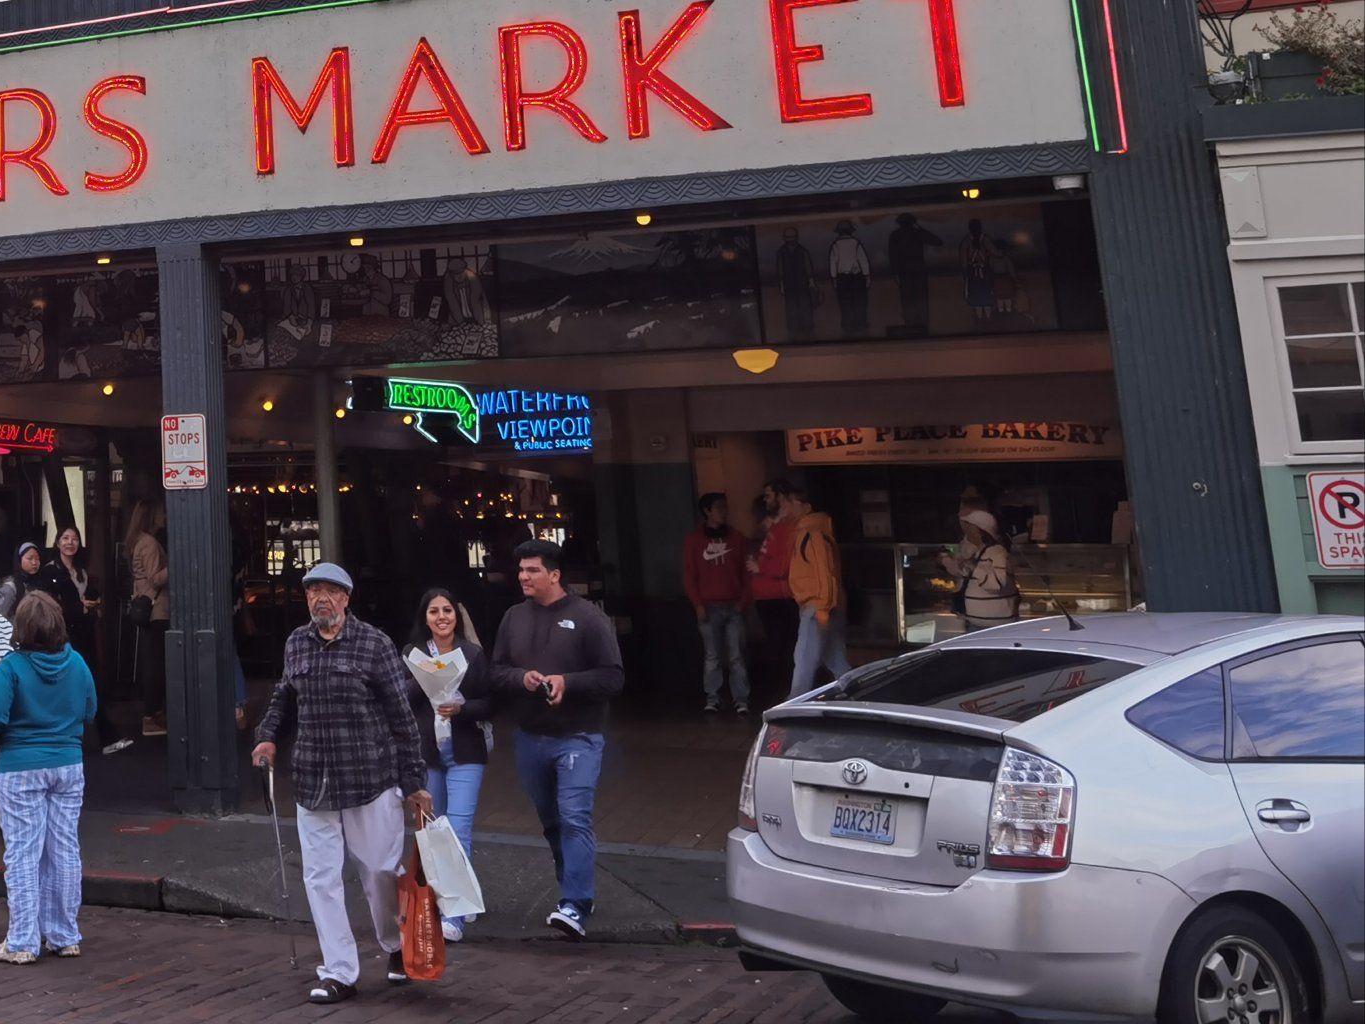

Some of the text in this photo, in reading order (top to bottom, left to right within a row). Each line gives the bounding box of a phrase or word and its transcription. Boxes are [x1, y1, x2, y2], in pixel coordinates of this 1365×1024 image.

[393, 384, 476, 429] RESTROOMS
[477, 389, 589, 415] WATERFR
[24, 422, 57, 444] CAFE
[164, 419, 176, 429] NO
[168, 432, 201, 446] STOPS
[514, 441, 521, 450] &
[522, 440, 553, 450] PUBLIC
[797, 421, 1110, 452] PIKE PLACE BAKERY
[834, 806, 891, 835] BQX2314
[937, 840, 981, 854] PRIUS
